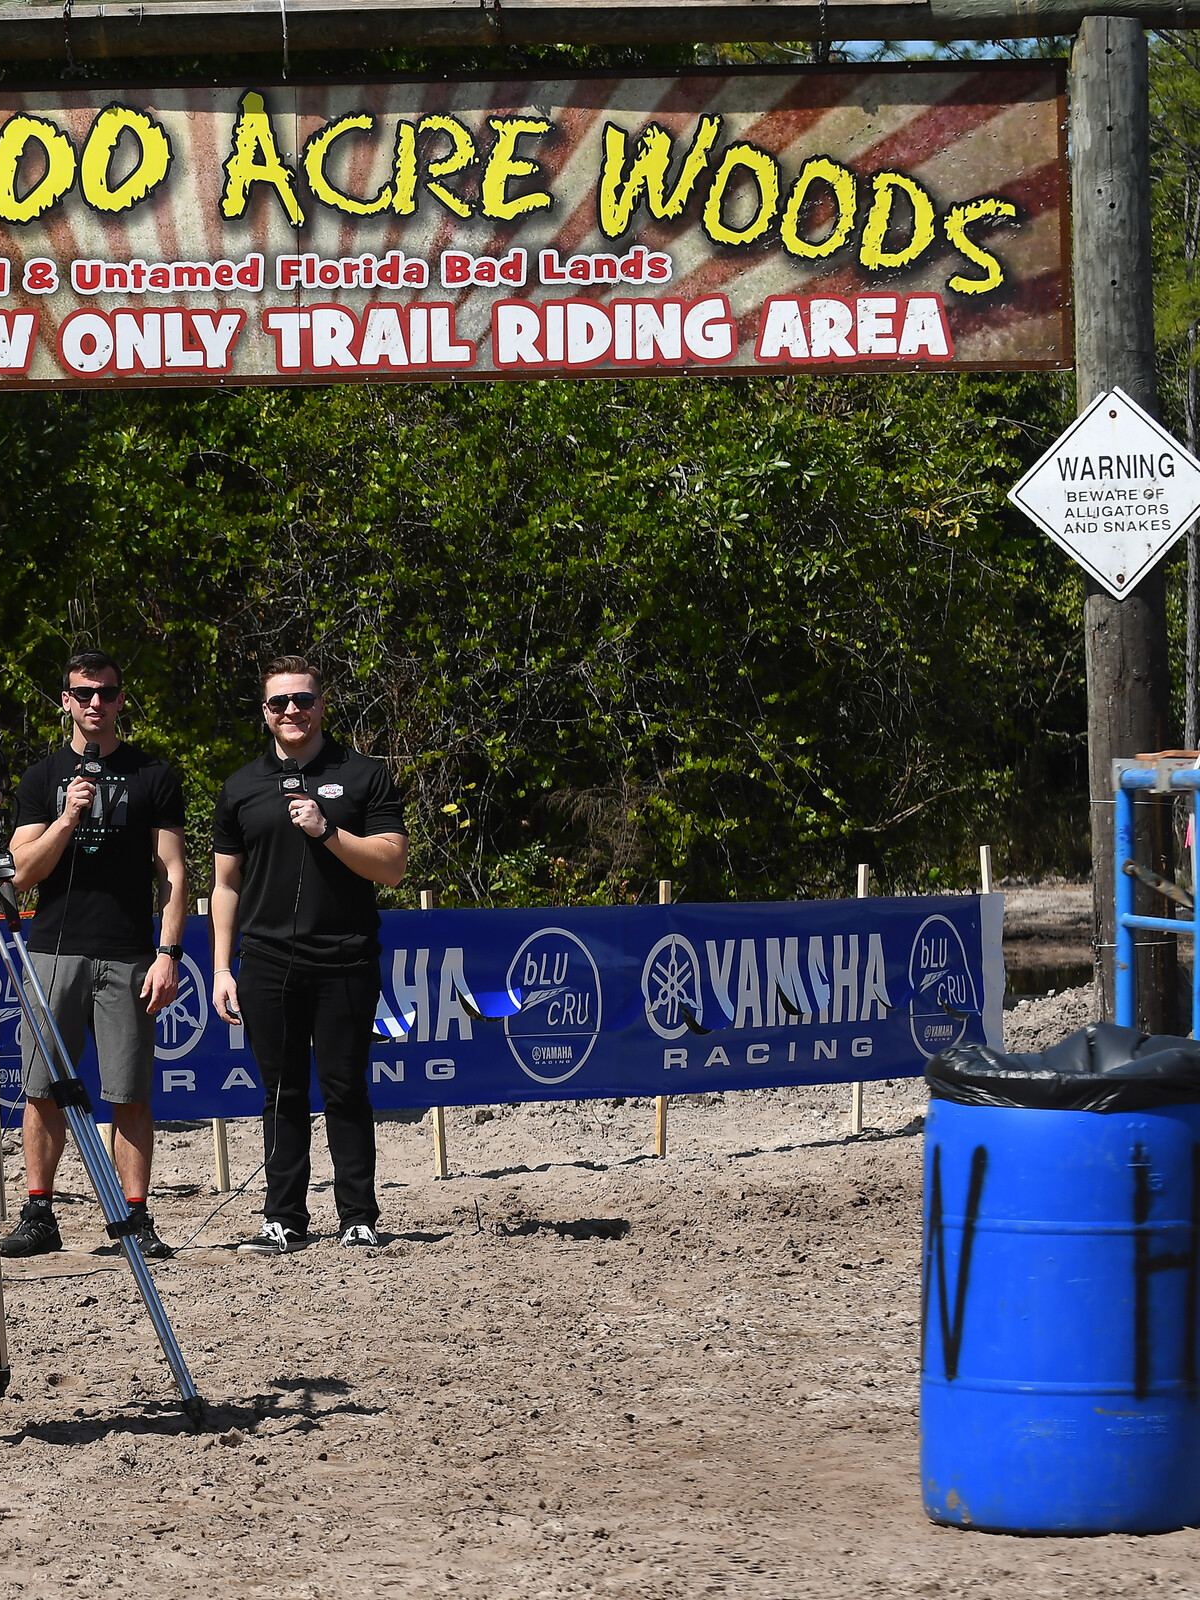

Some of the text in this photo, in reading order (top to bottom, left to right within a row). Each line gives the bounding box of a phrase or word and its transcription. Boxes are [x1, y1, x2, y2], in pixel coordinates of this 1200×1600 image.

[222, 91, 551, 224] ACRE
[601, 115, 1016, 294] WOODS
[28, 263, 55, 289] &
[76, 258, 260, 289] Untamed
[280, 256, 425, 286] Florida
[445, 253, 522, 284] Bad
[544, 250, 668, 280] Lands
[61, 312, 241, 373] ONLY
[267, 307, 471, 368] TRAIL
[497, 298, 732, 364] RIDING
[759, 296, 949, 358] AREA
[1057, 453, 1175, 481] WARNING
[1066, 488, 1165, 503] BEWARE OF
[1064, 504, 1169, 518] ALLIGATORS
[1063, 519, 1171, 534] AND SNAKES
[705, 933, 893, 1028] YAMAHA
[930, 1024, 953, 1037] YAMAHA
[541, 1046, 573, 1059] YAMAHA
[663, 1036, 873, 1070] RACING
